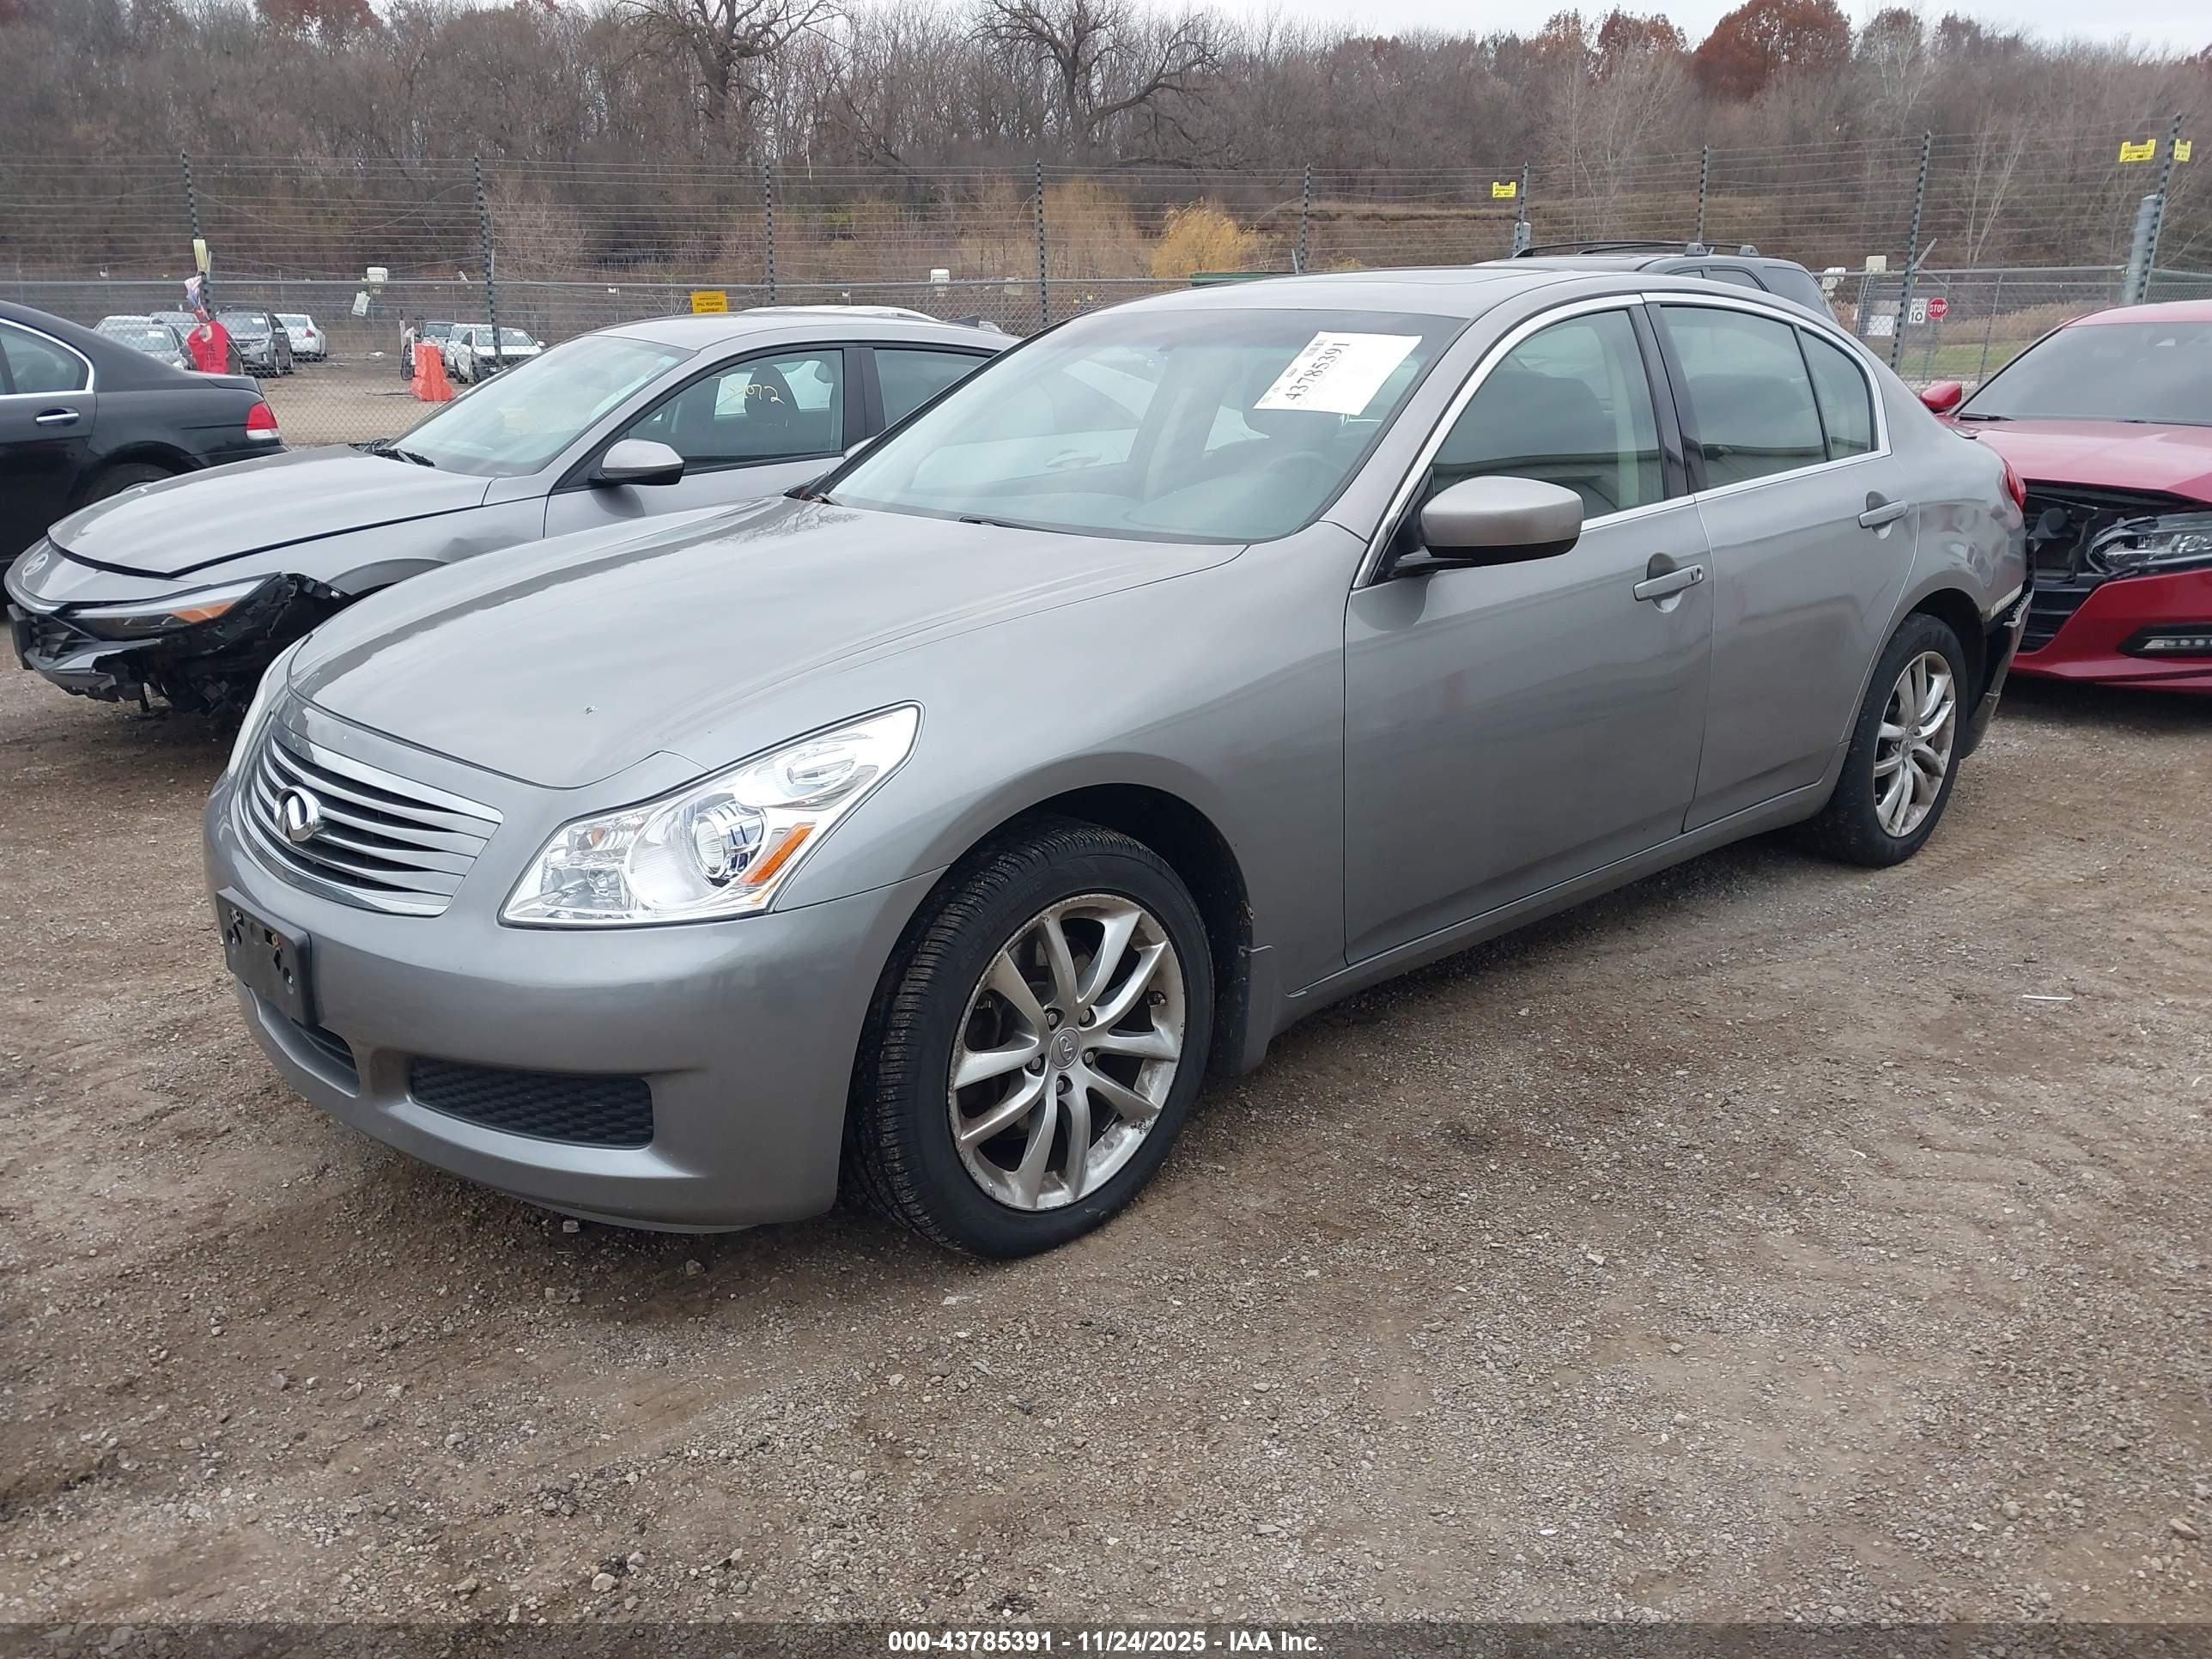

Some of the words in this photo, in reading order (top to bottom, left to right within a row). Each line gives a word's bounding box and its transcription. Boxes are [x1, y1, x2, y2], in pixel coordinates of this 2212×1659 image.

[1929, 304, 1947, 313] STOP
[1911, 312, 1923, 321] 10
[1285, 343, 1351, 400] 43785391
